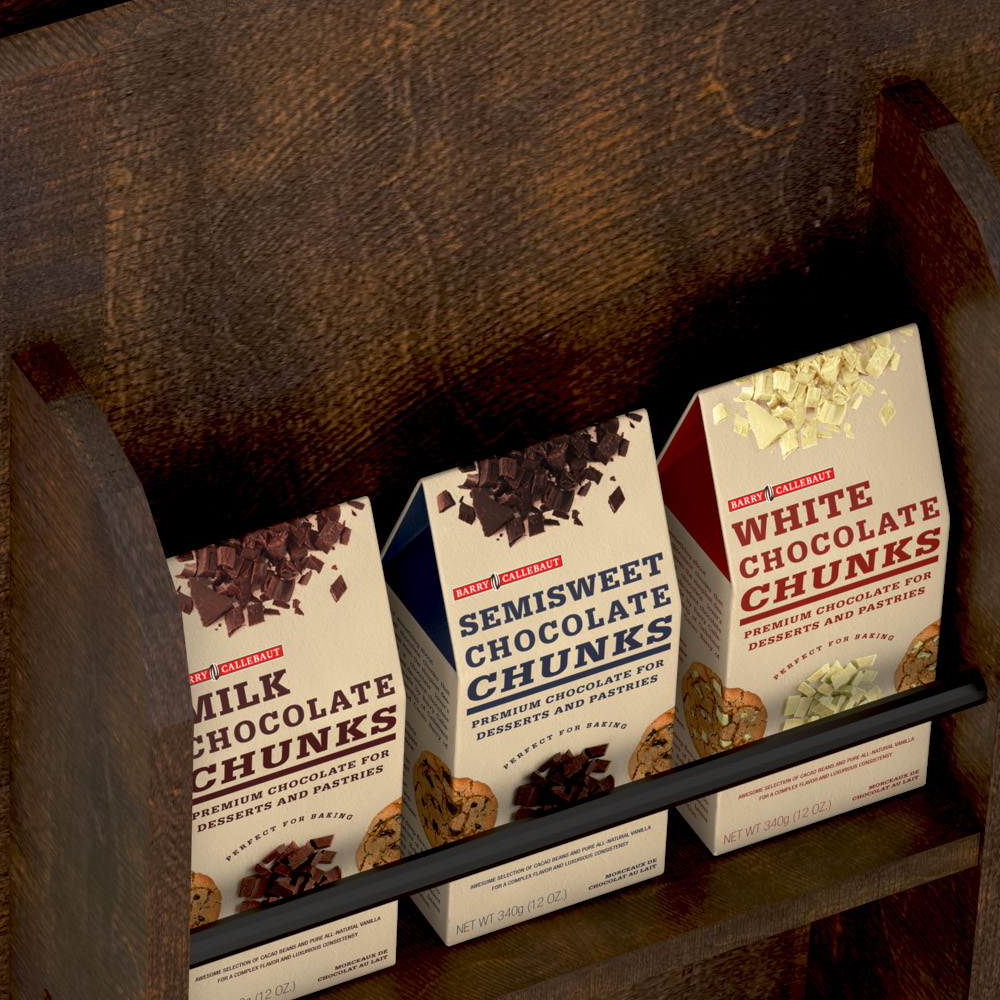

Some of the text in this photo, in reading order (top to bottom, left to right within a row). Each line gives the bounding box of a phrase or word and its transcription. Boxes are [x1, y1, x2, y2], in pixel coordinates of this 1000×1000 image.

[731, 470, 833, 510] BARRY CALLEBAUT
[731, 480, 873, 547] WHITE
[739, 496, 941, 579] CHOCOLATE
[456, 558, 560, 598] BARRY CALLEBAUT
[459, 552, 664, 638] SEMISWEET
[740, 527, 942, 612] CHUNKS
[465, 584, 672, 668] CHOCOLATE
[743, 571, 932, 639] PREMIUM CHOCOLATE FOR
[748, 586, 926, 651] DESSERTS AND PASTRIES
[221, 647, 280, 673] CALLEBAUT
[467, 614, 673, 702] CHUNKS
[773, 632, 895, 680] PERFECT FOR BAKING
[192, 673, 396, 760] CHOCOLATE
[471, 659, 664, 729] PREMIUM CHOCOLATE FOR
[476, 674, 659, 741] DESSERTS AND PASTRIES
[192, 704, 397, 793] CHUNKS
[503, 721, 628, 770] PERFECT FOR BAKING
[192, 749, 390, 820] PREMIUM CHOCOLATE FOR
[197, 764, 384, 832] DESSERTS AND PASTRIES
[851, 785, 890, 801] CHOCOLAT
[902, 775, 920, 785] LAIT
[868, 773, 909, 790] MORCEAUX
[225, 811, 354, 862] PERFECT FOR BAKING
[723, 800, 832, 845] NET WT 340g (12 OZ.)
[588, 864, 657, 891] CHOCOLAT AU LAIT
[605, 858, 658, 879] MORCEAUX DE
[456, 889, 568, 935] NET WT 340g (12 OZ.)
[317, 965, 357, 982] CHOCOLAT
[370, 954, 388, 964] LAIT
[334, 948, 388, 970] MORCEAUX DE
[275, 980, 296, 996] OZ.)
